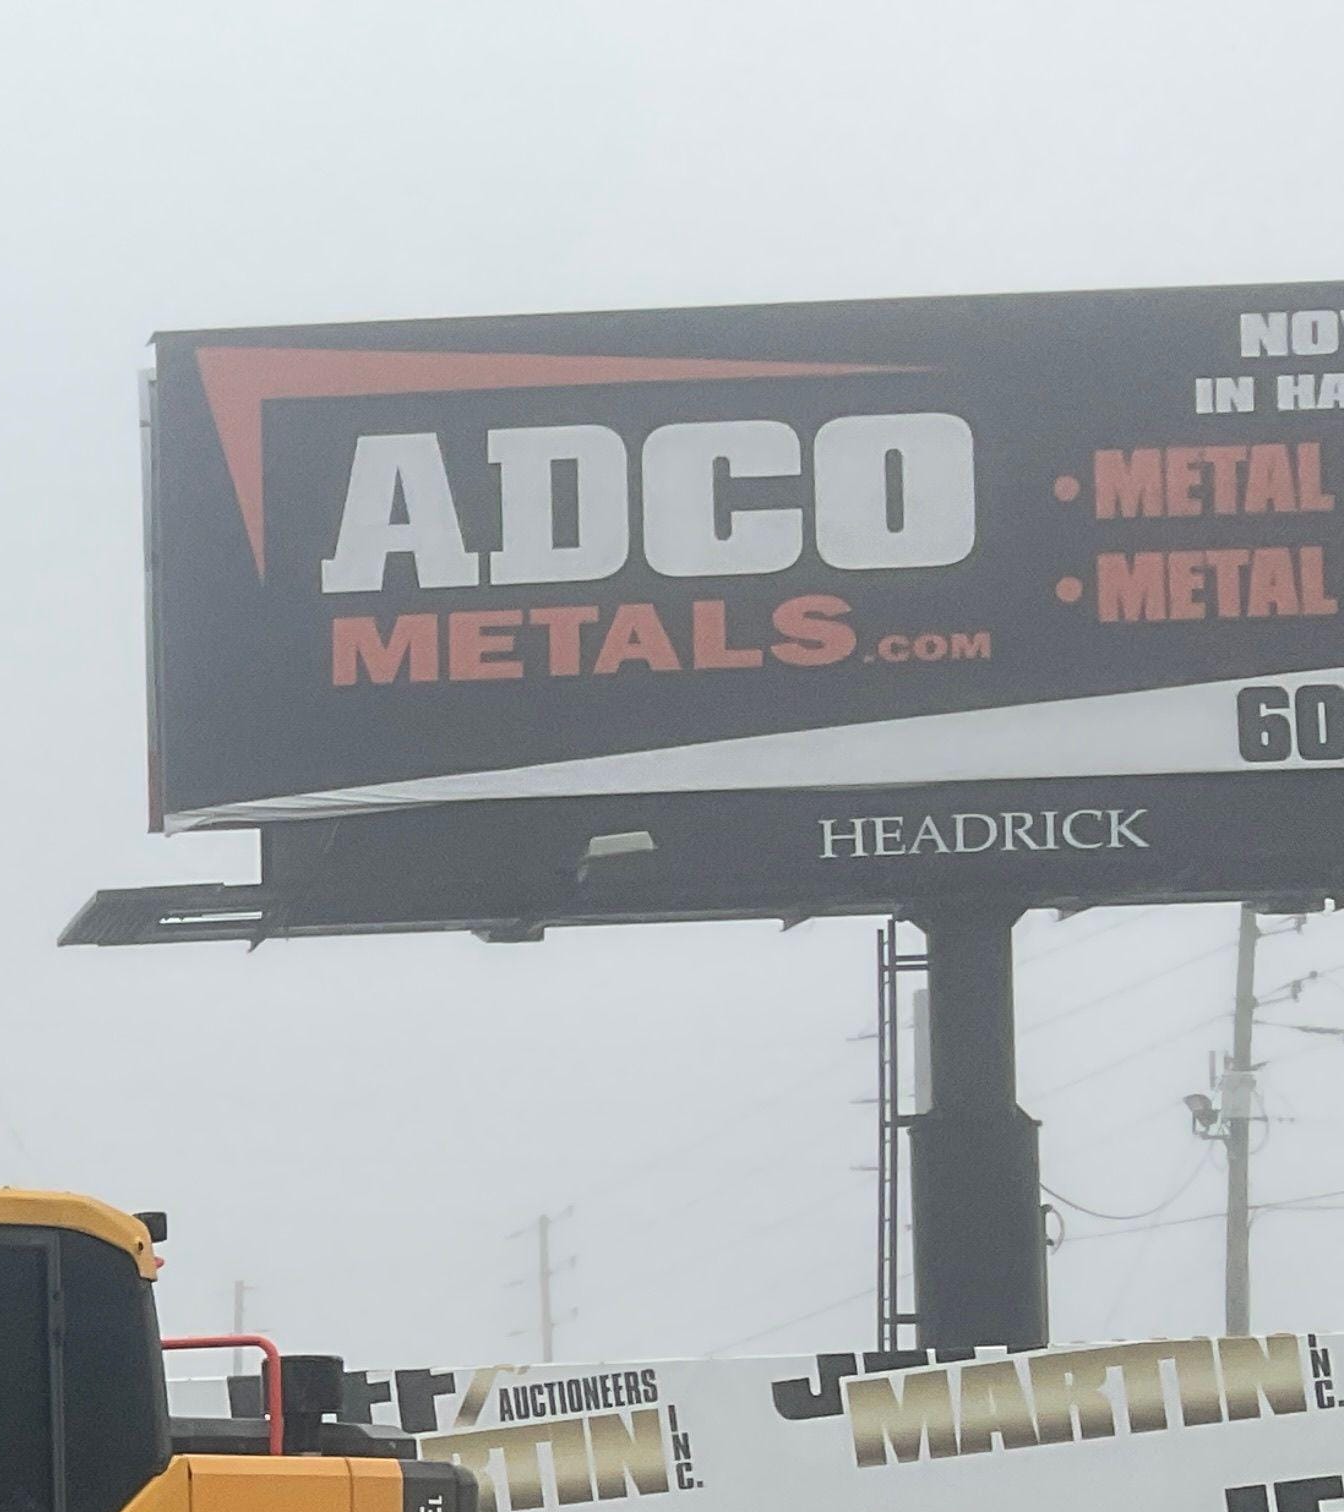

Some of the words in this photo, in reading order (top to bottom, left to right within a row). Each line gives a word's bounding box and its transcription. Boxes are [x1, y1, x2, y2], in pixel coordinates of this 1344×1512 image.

[1240, 309, 1344, 358] NO
[1195, 376, 1255, 414] IN
[321, 412, 976, 593] ADCO
[1093, 442, 1336, 519] METAL
[1096, 546, 1339, 622] METAL
[817, 808, 1150, 859] HEADRICK
[498, 1368, 659, 1423] AUCTIONEERS
[847, 1332, 1307, 1468] MARTIN
